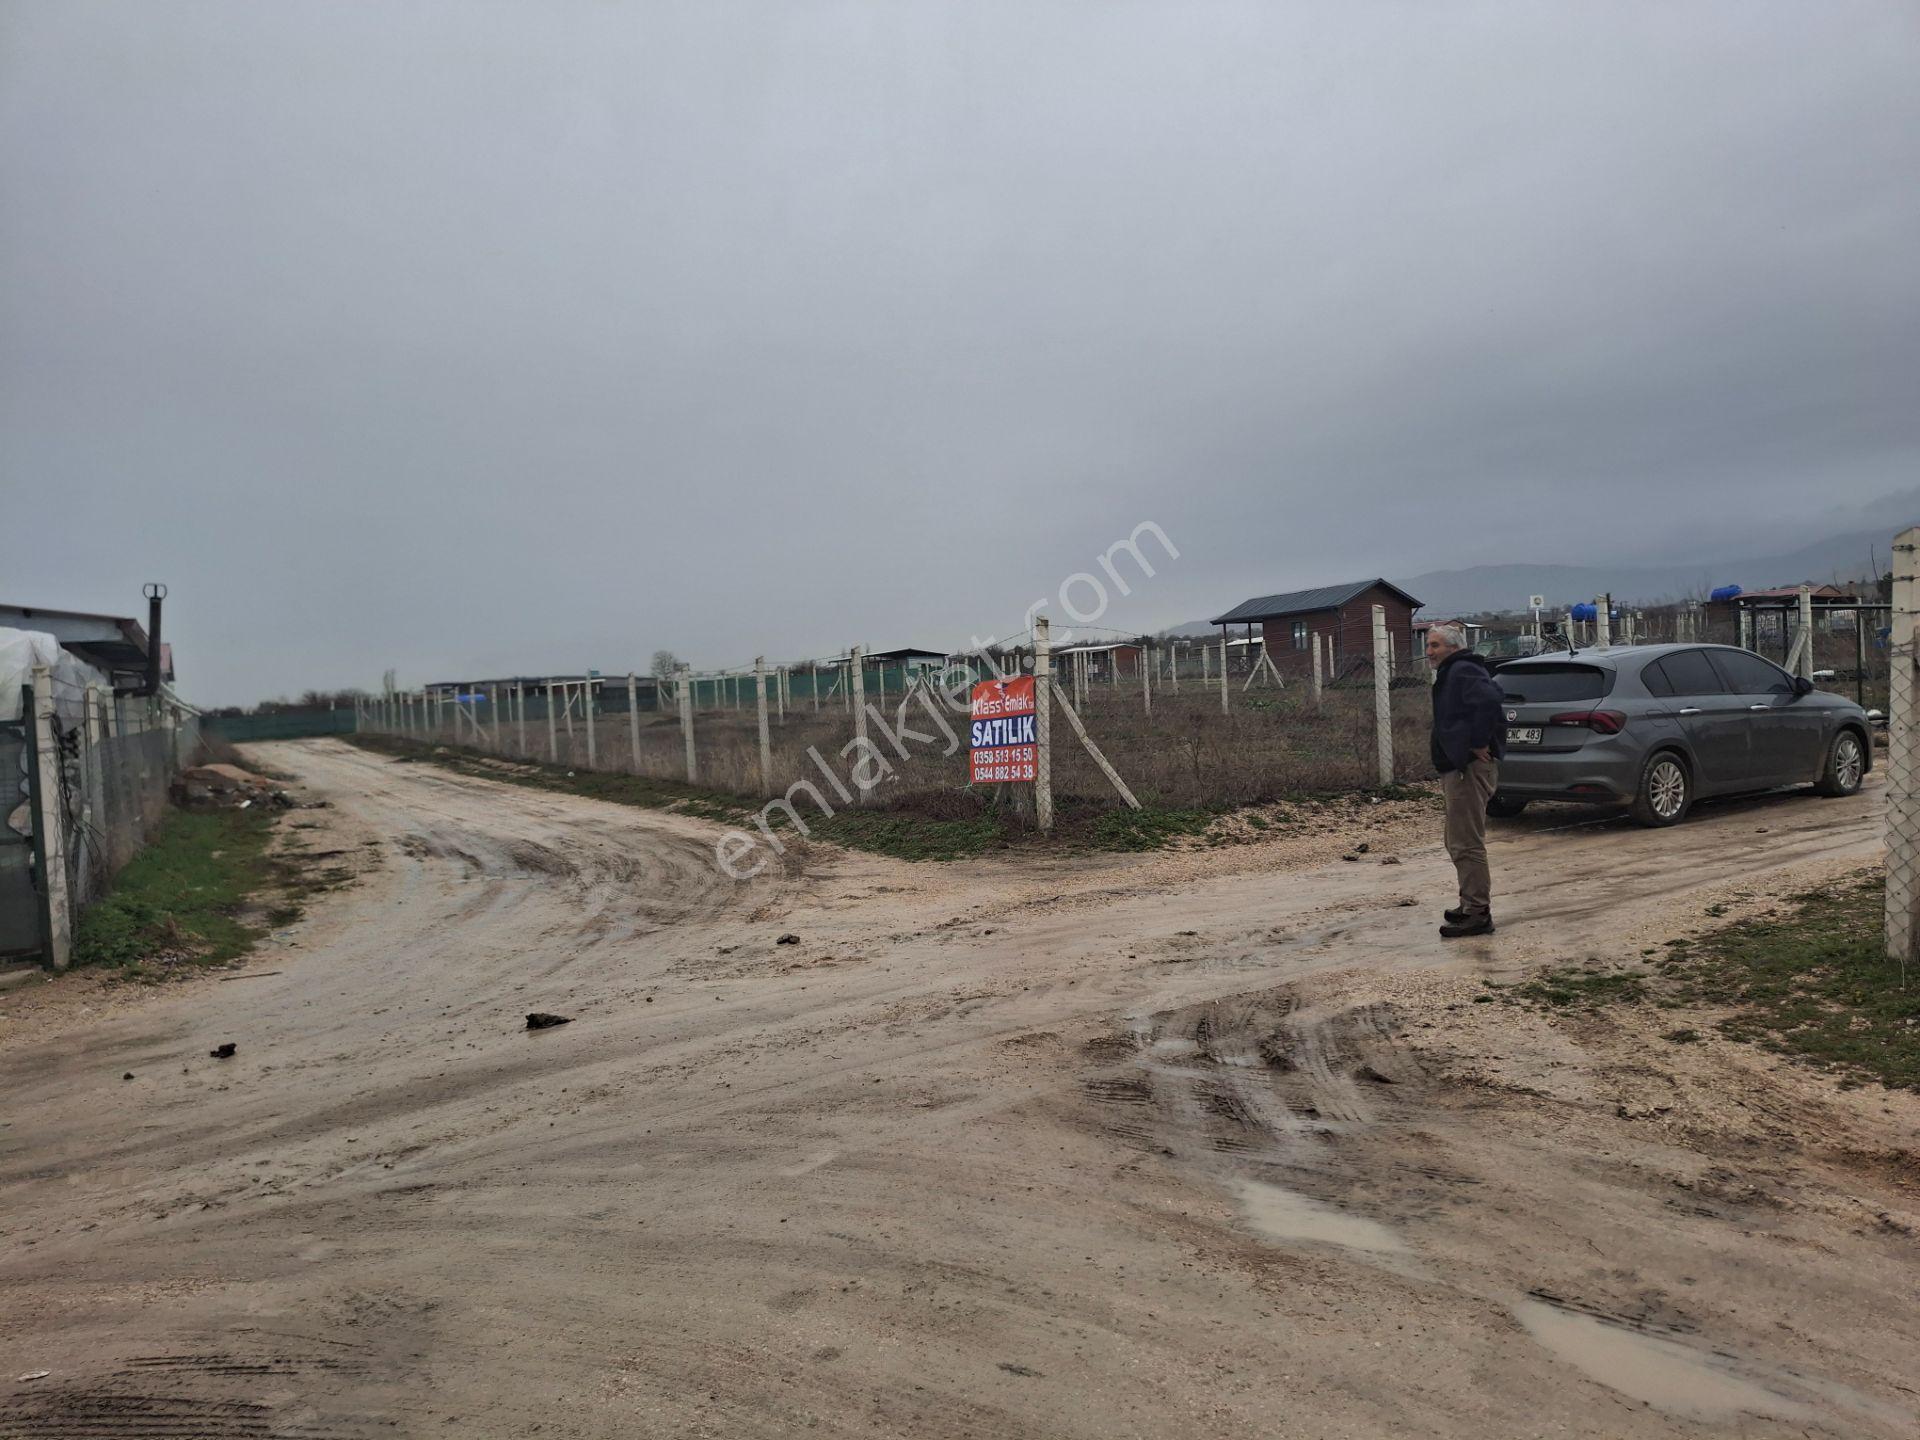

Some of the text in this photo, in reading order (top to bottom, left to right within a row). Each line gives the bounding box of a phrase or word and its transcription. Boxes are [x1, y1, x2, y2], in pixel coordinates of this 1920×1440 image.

[972, 698, 1001, 716] Klass
[1004, 693, 1028, 712] Emlak
[971, 716, 1035, 748] SATILIK
[1525, 729, 1541, 740] 483
[995, 749, 1009, 763] 513
[1011, 748, 1021, 762] 15
[1023, 747, 1033, 761] 50
[974, 767, 993, 780] 0544
[1011, 765, 1021, 779] 54
